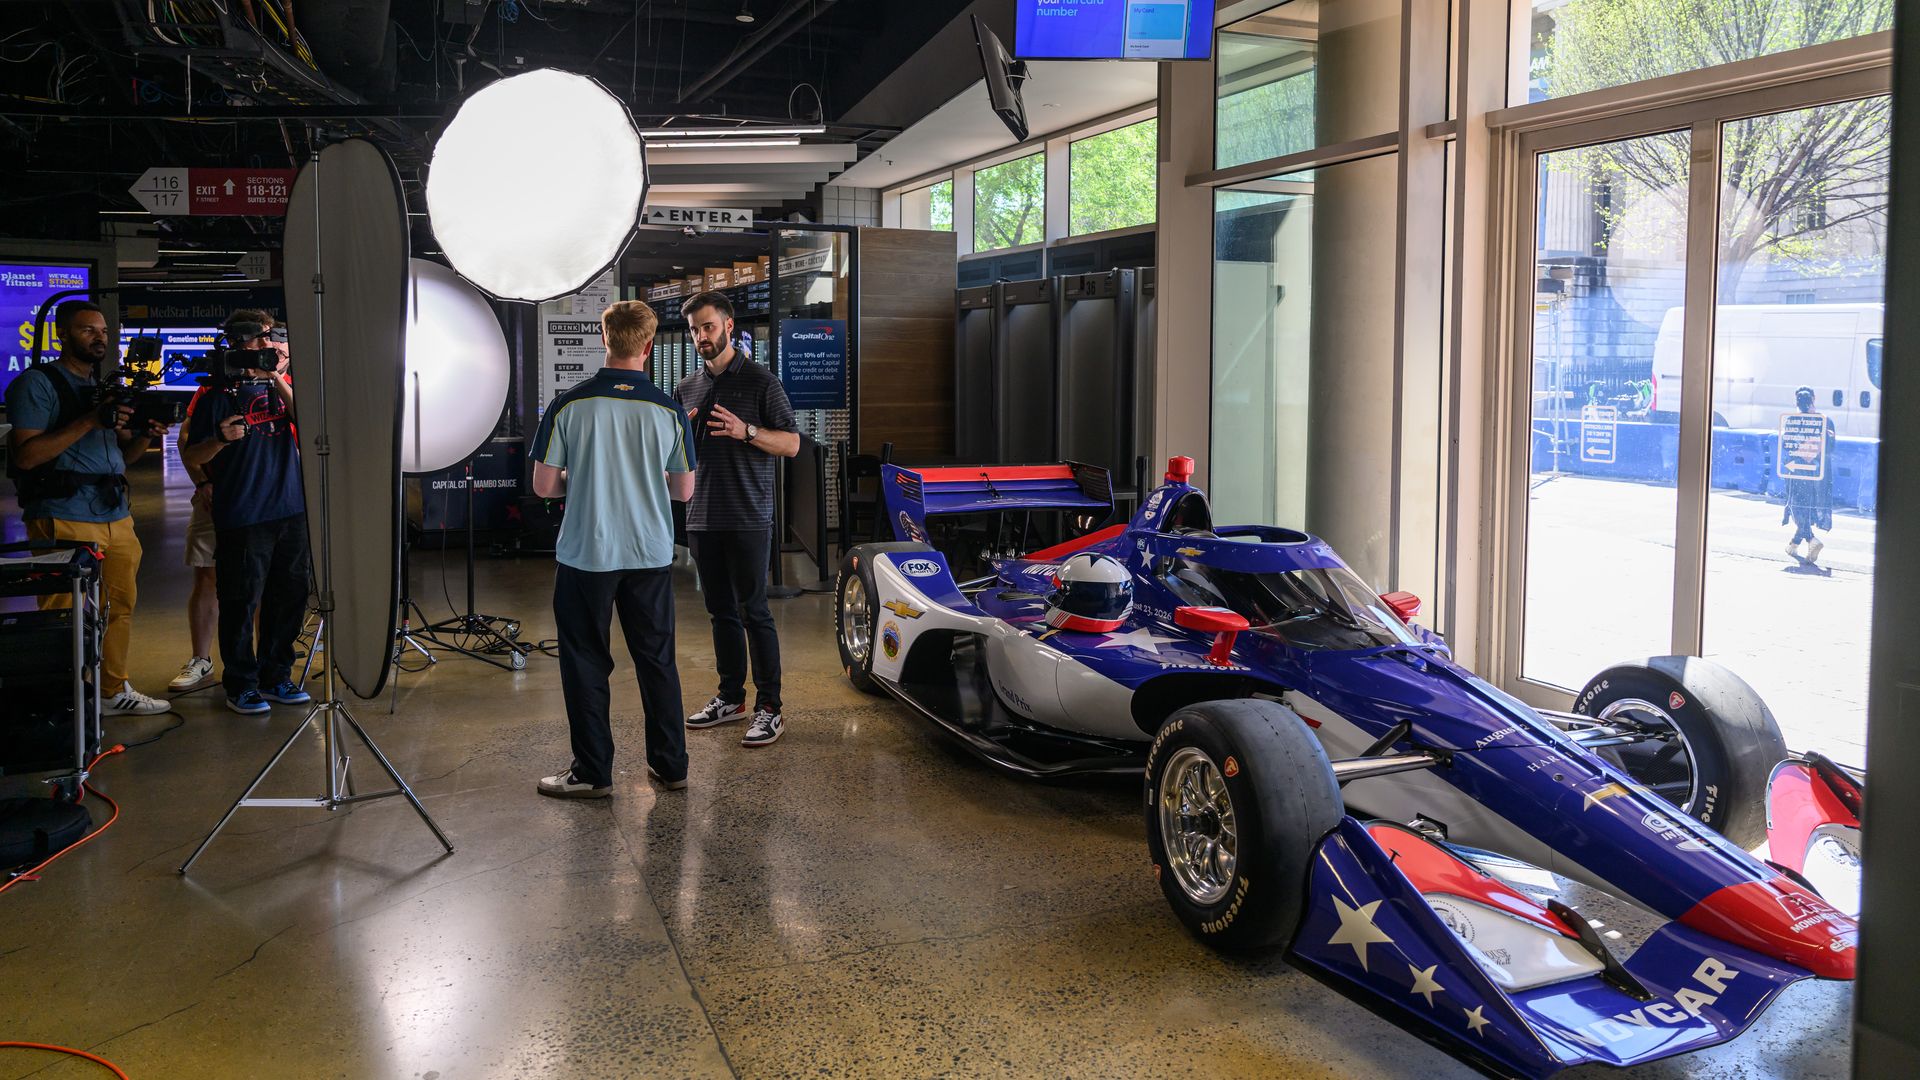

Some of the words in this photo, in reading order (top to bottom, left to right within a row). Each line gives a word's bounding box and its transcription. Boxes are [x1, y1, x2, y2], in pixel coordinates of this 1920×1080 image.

[1036, 7, 1078, 17] number
[153, 176, 179, 189] 116
[196, 186, 217, 195] EXIT
[246, 185, 287, 196] 118-121
[153, 193, 179, 206] 117
[670, 210, 732, 223] ENTER
[1, 272, 36, 281] planet
[6, 279, 43, 287] fitness
[150, 305, 191, 318] MedStar
[192, 304, 225, 318] Health
[581, 323, 602, 333] MK
[168, 335, 198, 343] Gametime
[198, 335, 215, 343] trivia
[8, 356, 20, 371] A
[432, 481, 458, 489] CAPITAL
[458, 480, 470, 488] CIT
[473, 480, 497, 488] MAMBO
[498, 479, 517, 488] SAUCE
[908, 563, 931, 571] FOX
[1143, 605, 1153, 616] 23,
[1154, 608, 1172, 621] 2026
[1160, 662, 1251, 671] Firestone
[1145, 719, 1184, 781] Firestone
[1201, 875, 1250, 934] Firestone
[1543, 957, 1740, 1047] NDYCAR
